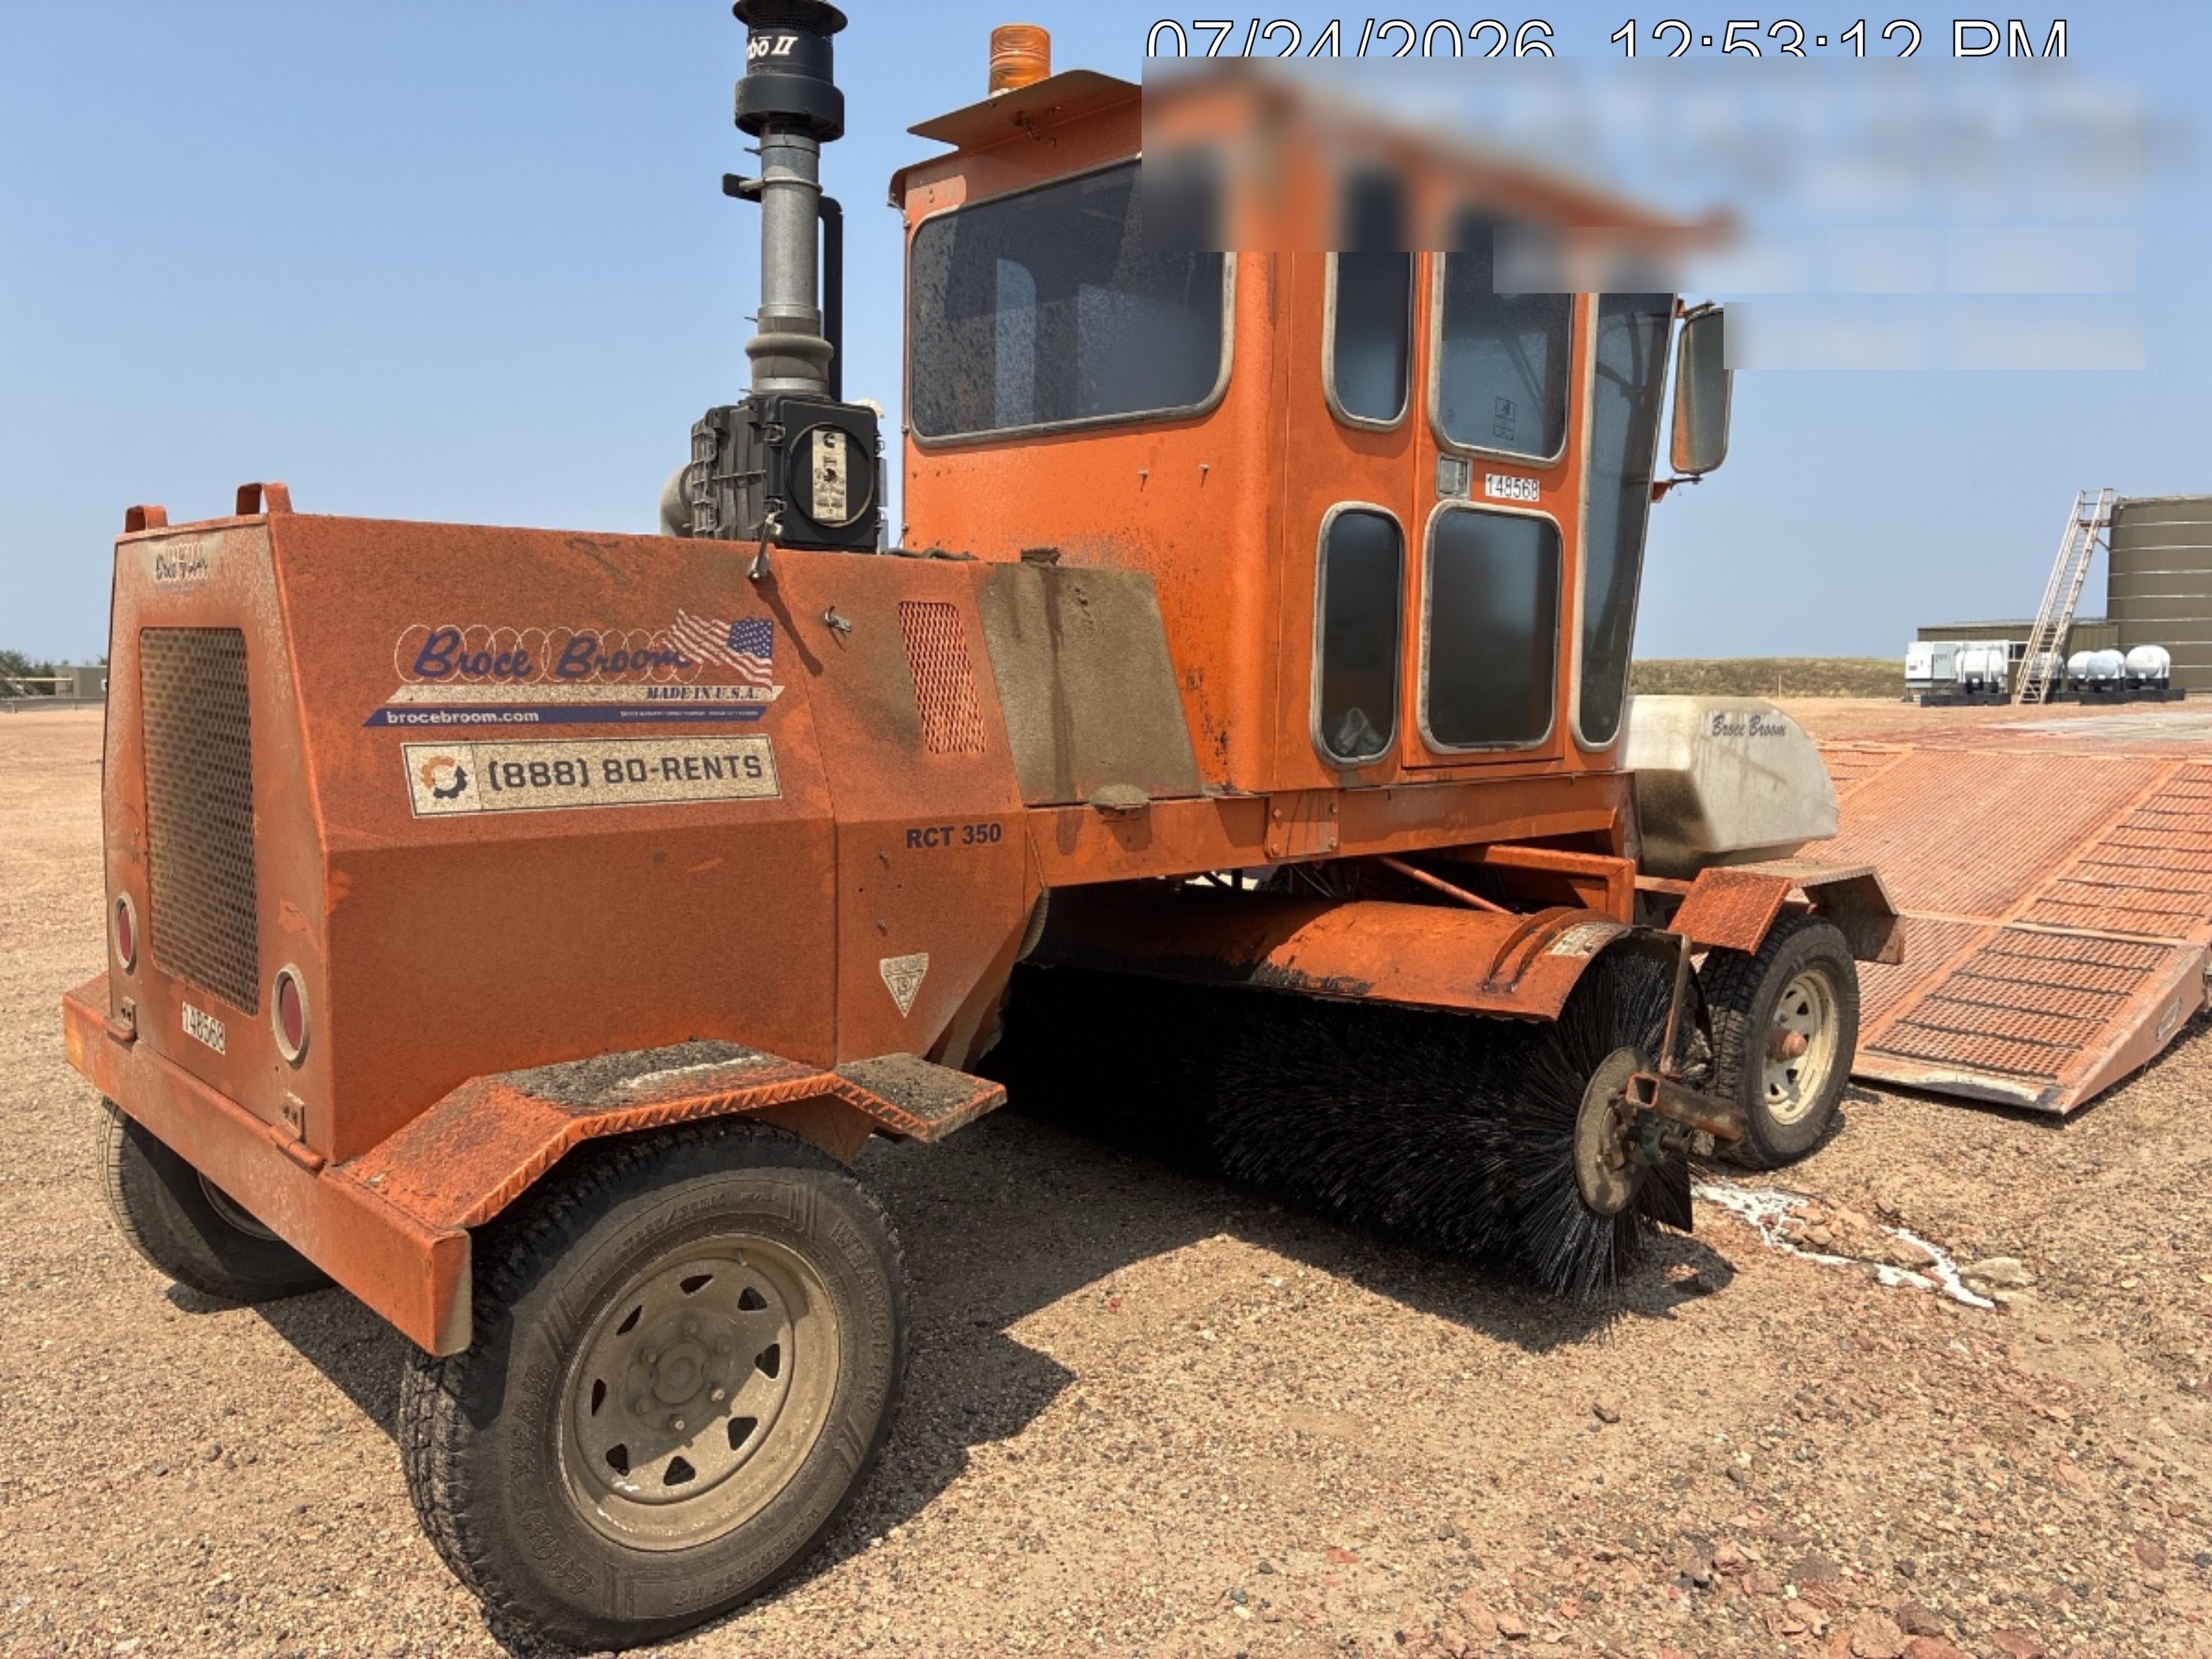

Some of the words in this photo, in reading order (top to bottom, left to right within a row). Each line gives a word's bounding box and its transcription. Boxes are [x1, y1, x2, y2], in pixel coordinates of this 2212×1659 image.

[1488, 475, 1539, 500] 148568
[414, 630, 533, 678] Broce
[556, 635, 692, 678] Broom
[646, 686, 689, 699] MADE
[693, 686, 710, 699] IN
[386, 710, 539, 724] brocebroom.com
[1712, 714, 1746, 737] Broce
[1749, 715, 1787, 737] Broom
[488, 758, 589, 791] (888)
[602, 755, 763, 783] 80-RENTS
[906, 826, 955, 849] RCT
[962, 823, 1002, 845] 350
[184, 1005, 224, 1052] 148568
